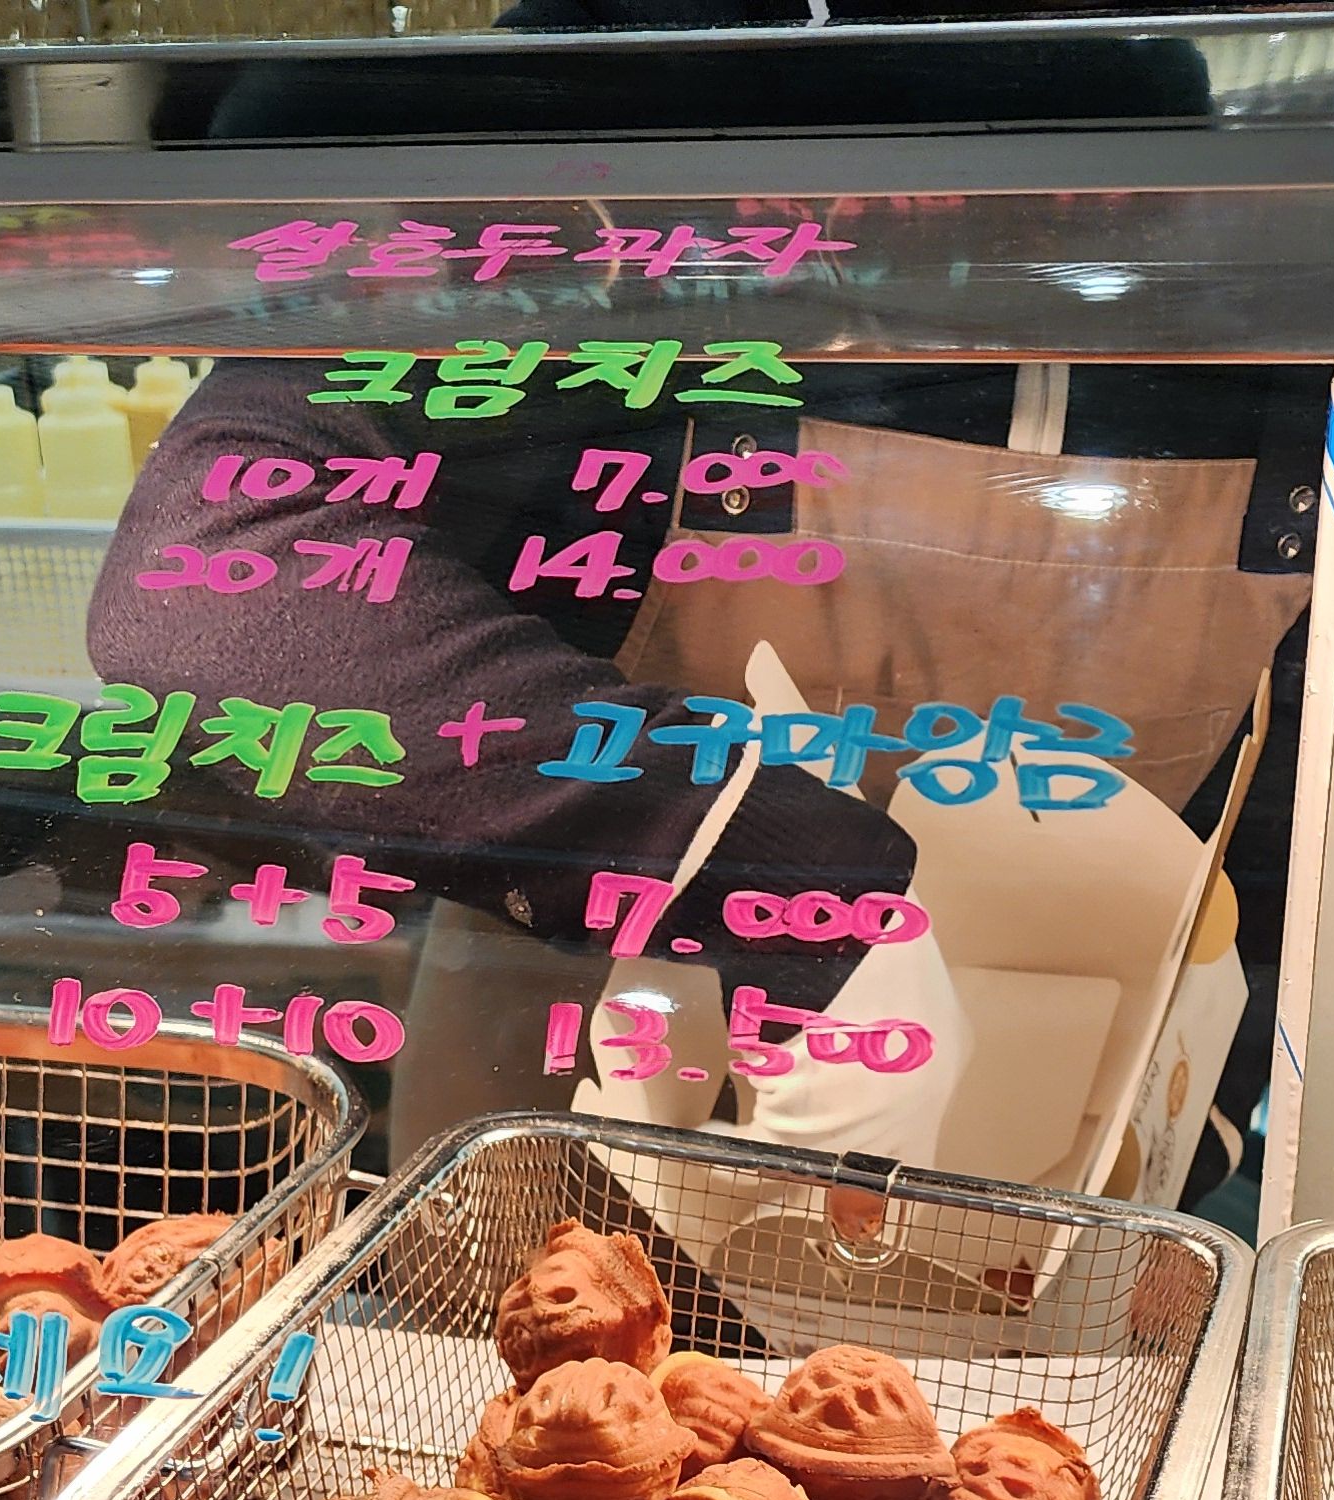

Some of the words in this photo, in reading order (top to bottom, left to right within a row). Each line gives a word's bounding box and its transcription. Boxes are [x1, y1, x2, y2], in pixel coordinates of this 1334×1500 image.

[310, 340, 800, 418] 크림치즈
[570, 447, 851, 514] 7.000
[507, 529, 849, 601] 14.000
[537, 696, 1133, 811] 고구마앙금
[583, 870, 932, 961] 7.000
[543, 984, 936, 1082] 13.500
